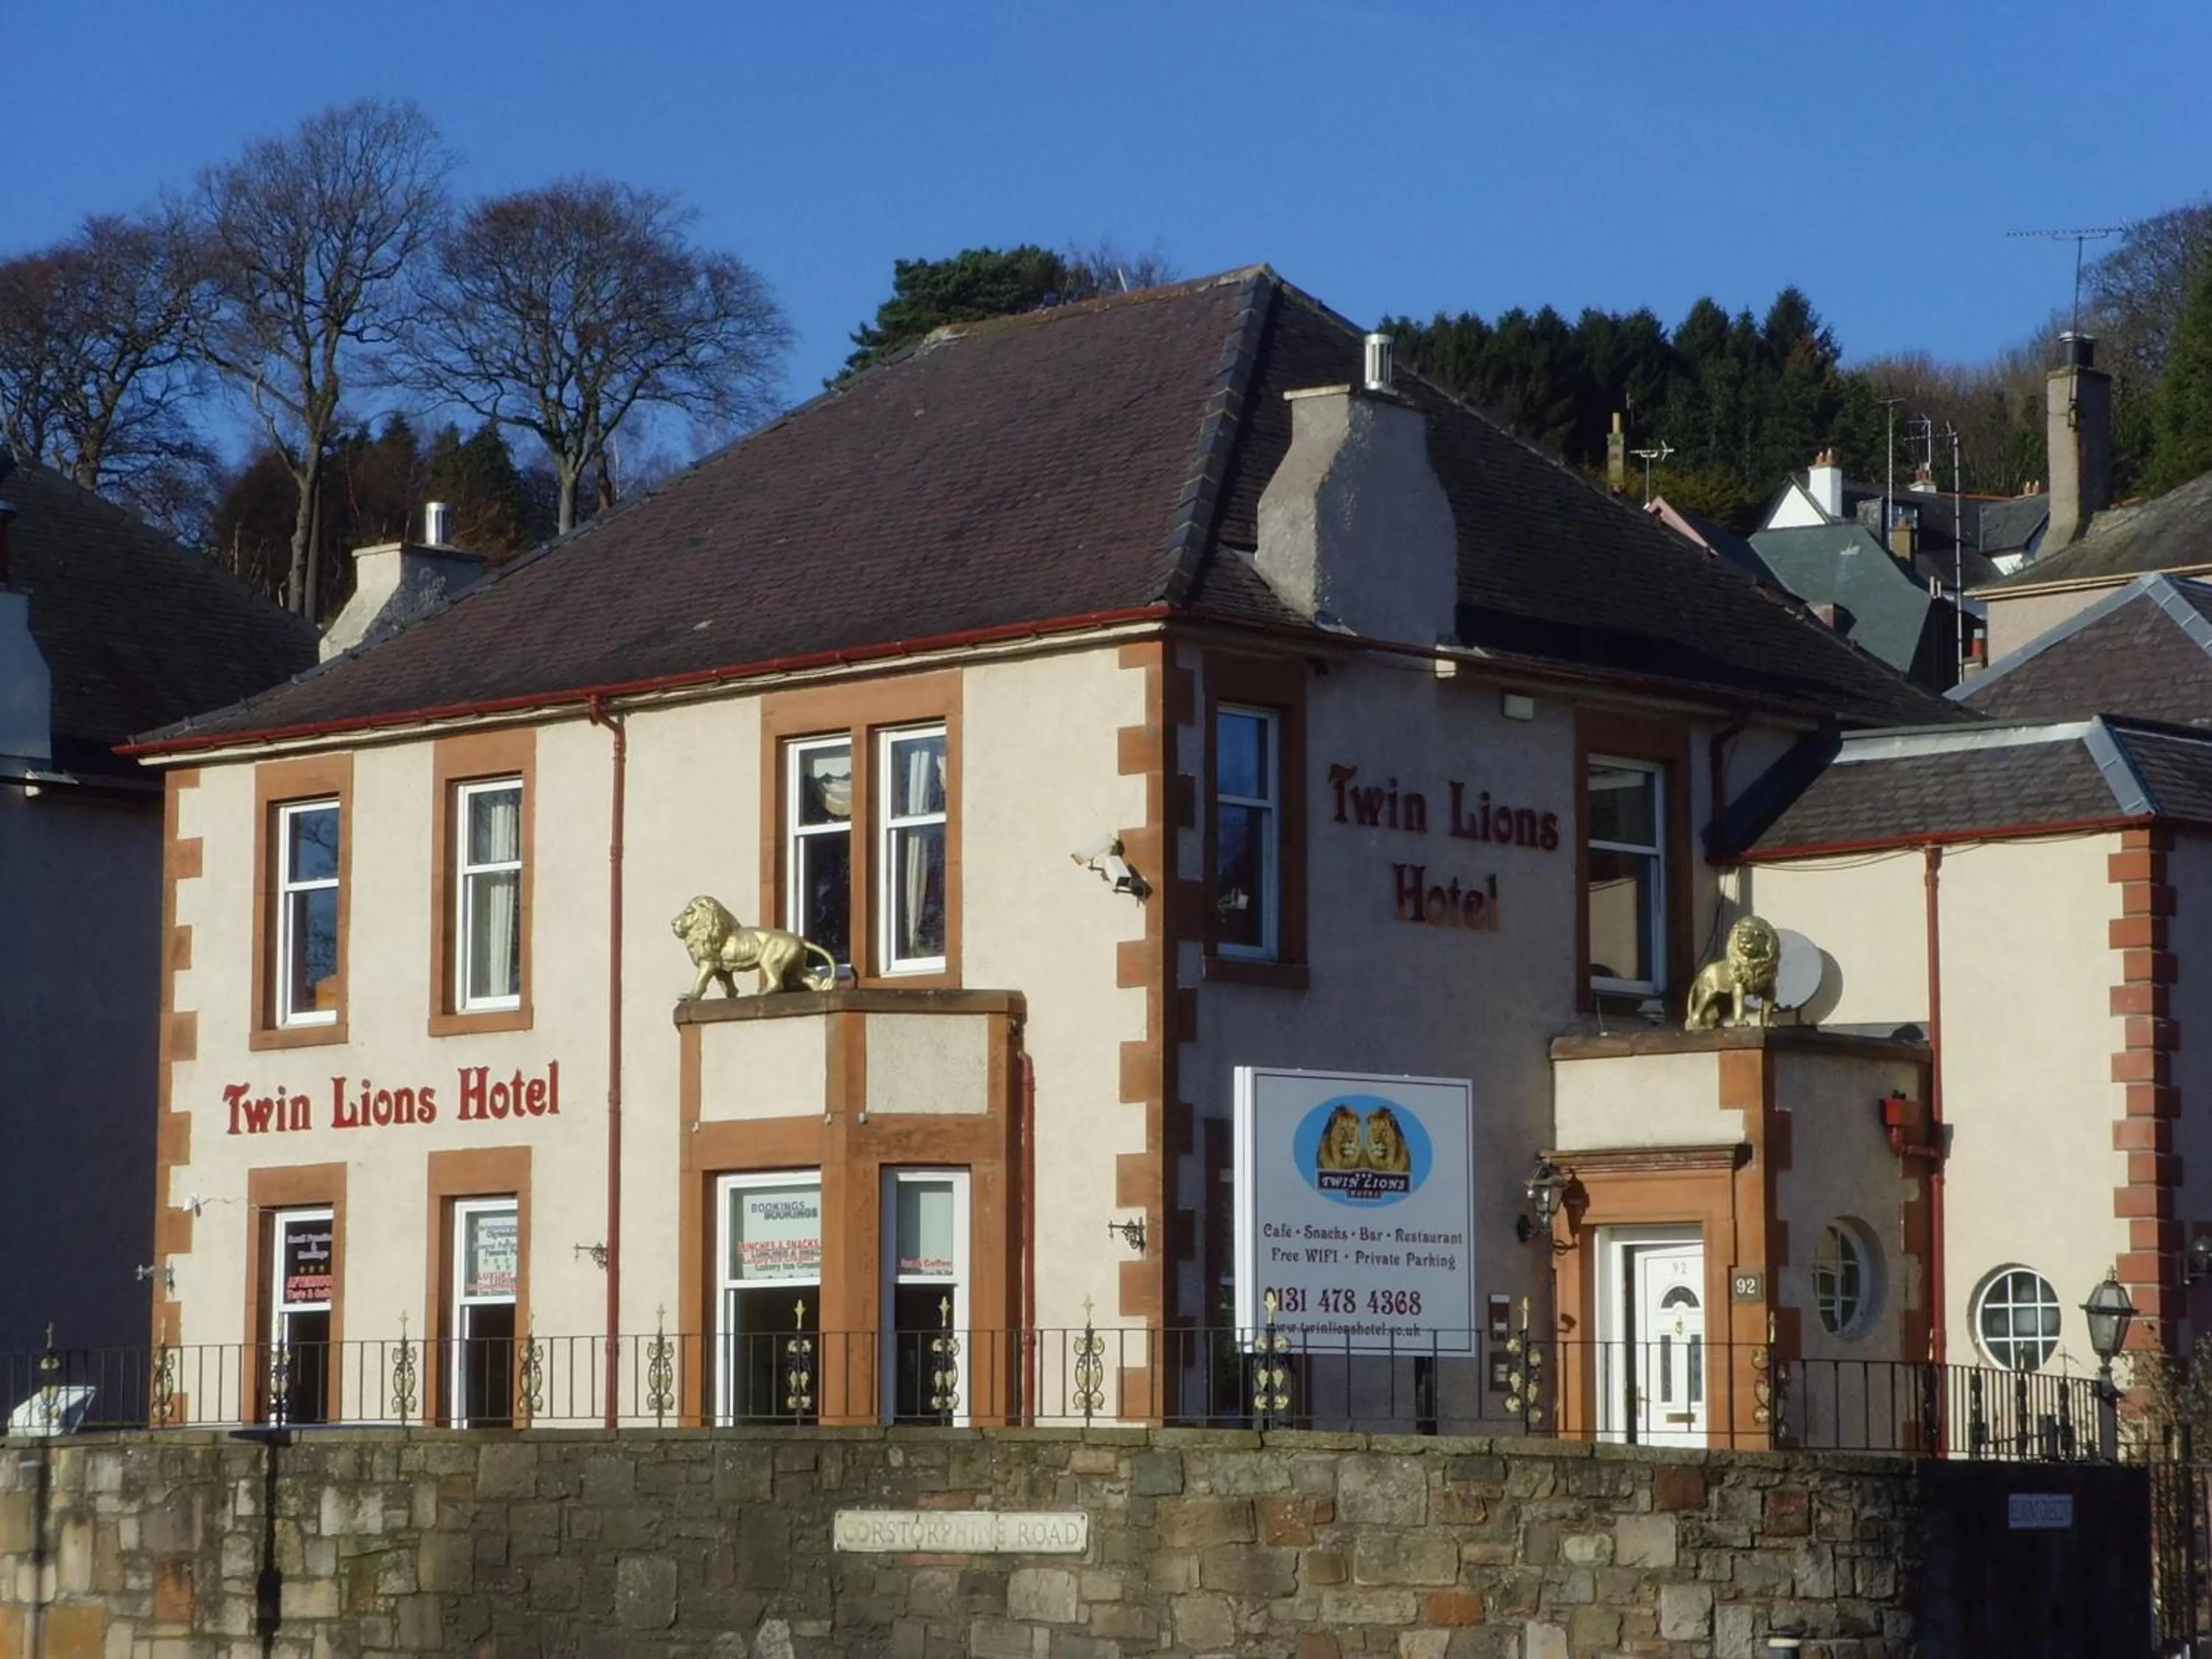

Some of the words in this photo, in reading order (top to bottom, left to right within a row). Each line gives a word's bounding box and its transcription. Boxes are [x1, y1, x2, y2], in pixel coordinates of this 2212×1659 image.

[1328, 764, 1427, 832] Twin
[1449, 780, 1559, 851] Lions
[1393, 863, 1501, 931] Hotel
[223, 1082, 312, 1135] Twin
[330, 1076, 437, 1127] Lions
[457, 1060, 560, 1120] Hotel
[1321, 1177, 1358, 1188] TWIN
[1364, 1178, 1405, 1189] LIONS
[751, 1201, 805, 1213] BOOKINGS
[1304, 1225, 1348, 1240] Snacks
[1360, 1227, 1383, 1241] Bar
[1395, 1228, 1464, 1244] Restaurant
[1271, 1248, 1298, 1262] Free
[1355, 1251, 1399, 1266] Private
[1407, 1252, 1455, 1270] Parking
[1672, 1262, 1686, 1274] 92
[1736, 1278, 1755, 1293] 92
[1319, 1288, 1356, 1313] 478
[1367, 1290, 1422, 1315] 4368
[1018, 1522, 1079, 1545] ROAD
